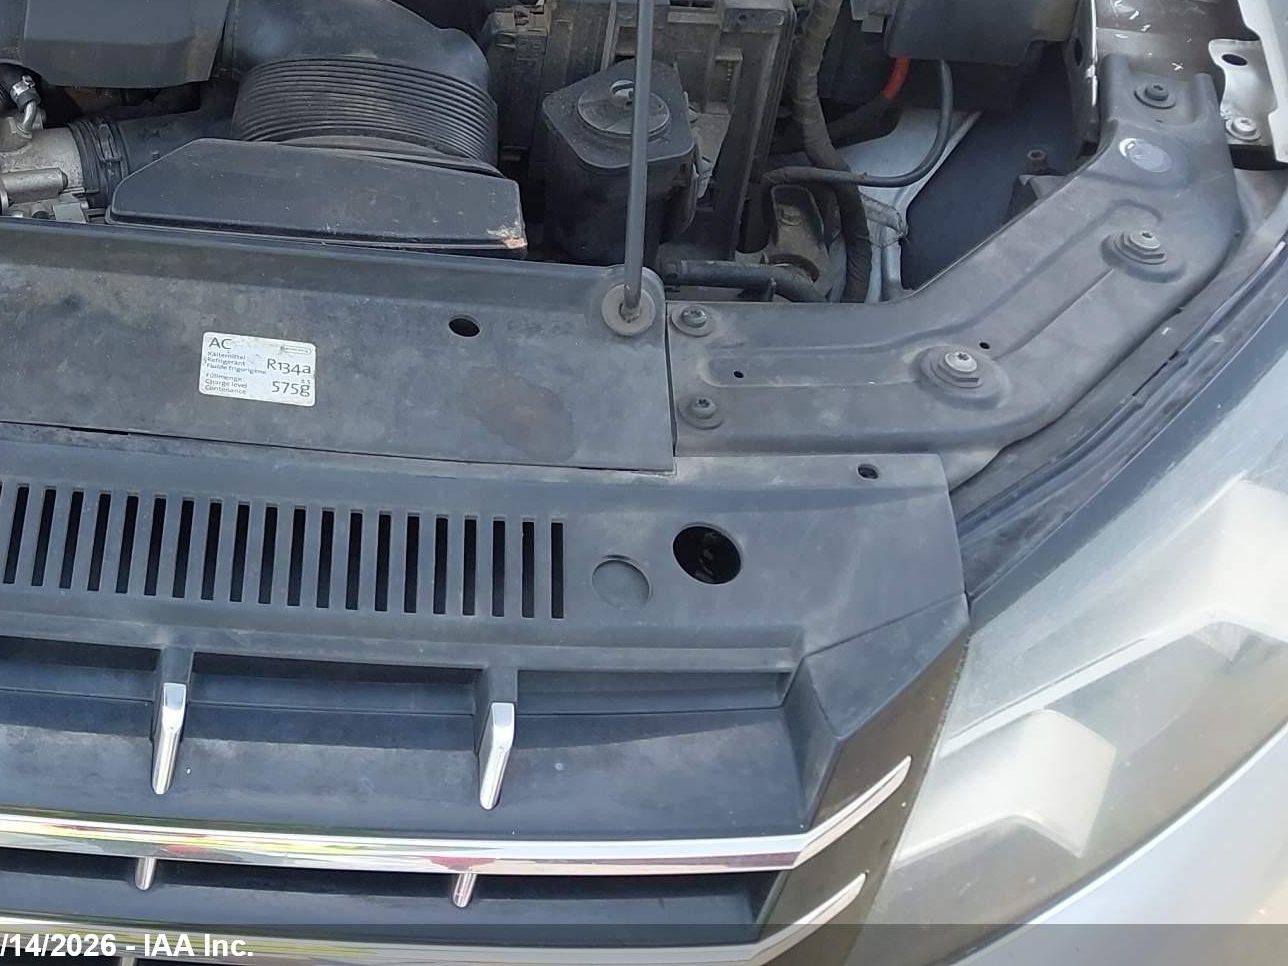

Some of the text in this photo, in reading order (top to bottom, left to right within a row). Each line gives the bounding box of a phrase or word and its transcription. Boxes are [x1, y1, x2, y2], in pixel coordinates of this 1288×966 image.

[208, 337, 232, 350] AC
[207, 357, 246, 366] Refrigerant
[267, 358, 311, 376] R134a
[204, 384, 246, 395] Contenance
[206, 379, 248, 389] Charge level
[272, 380, 310, 398] 575g
